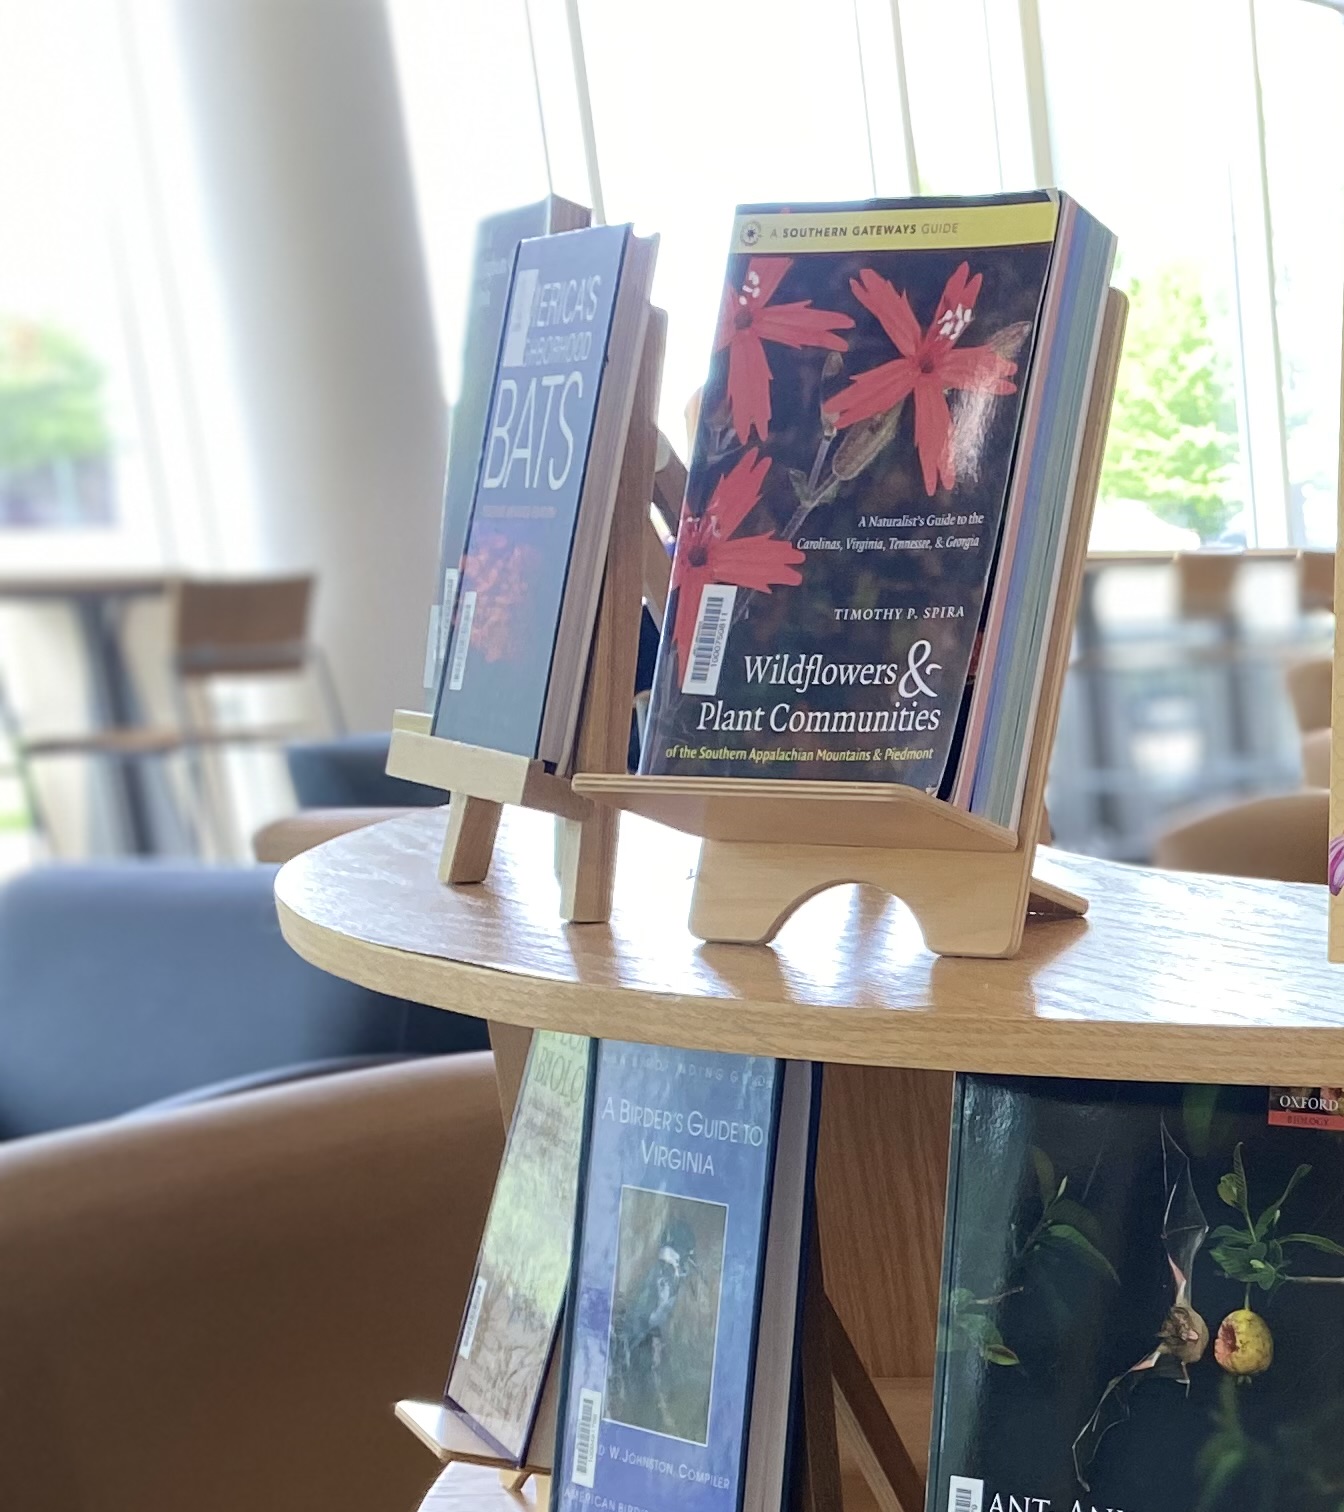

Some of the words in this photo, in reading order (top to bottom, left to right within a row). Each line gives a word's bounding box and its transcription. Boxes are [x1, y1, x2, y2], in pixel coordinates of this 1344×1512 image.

[770, 229, 778, 239] A
[783, 226, 847, 239] SOUTHERN
[852, 224, 917, 236] GATEWAYS
[921, 222, 960, 235] GUIDE
[483, 371, 583, 490] BATS
[834, 608, 902, 621] TIMOTHY
[906, 608, 918, 620] P.
[923, 605, 965, 619] SPIRA
[744, 654, 898, 692] Wildflowers
[899, 639, 942, 698] &
[696, 701, 772, 732] Plant
[769, 701, 941, 733] Communities
[665, 745, 679, 758] of
[679, 746, 697, 758] the
[699, 746, 747, 760] Southern
[748, 748, 814, 763] Appalachian
[817, 749, 871, 761] Mountains
[873, 749, 882, 760] &
[884, 747, 933, 761] Piedmont
[1280, 1095, 1339, 1112] OXFORD
[601, 1097, 615, 1121] A
[744, 1124, 763, 1146] TO
